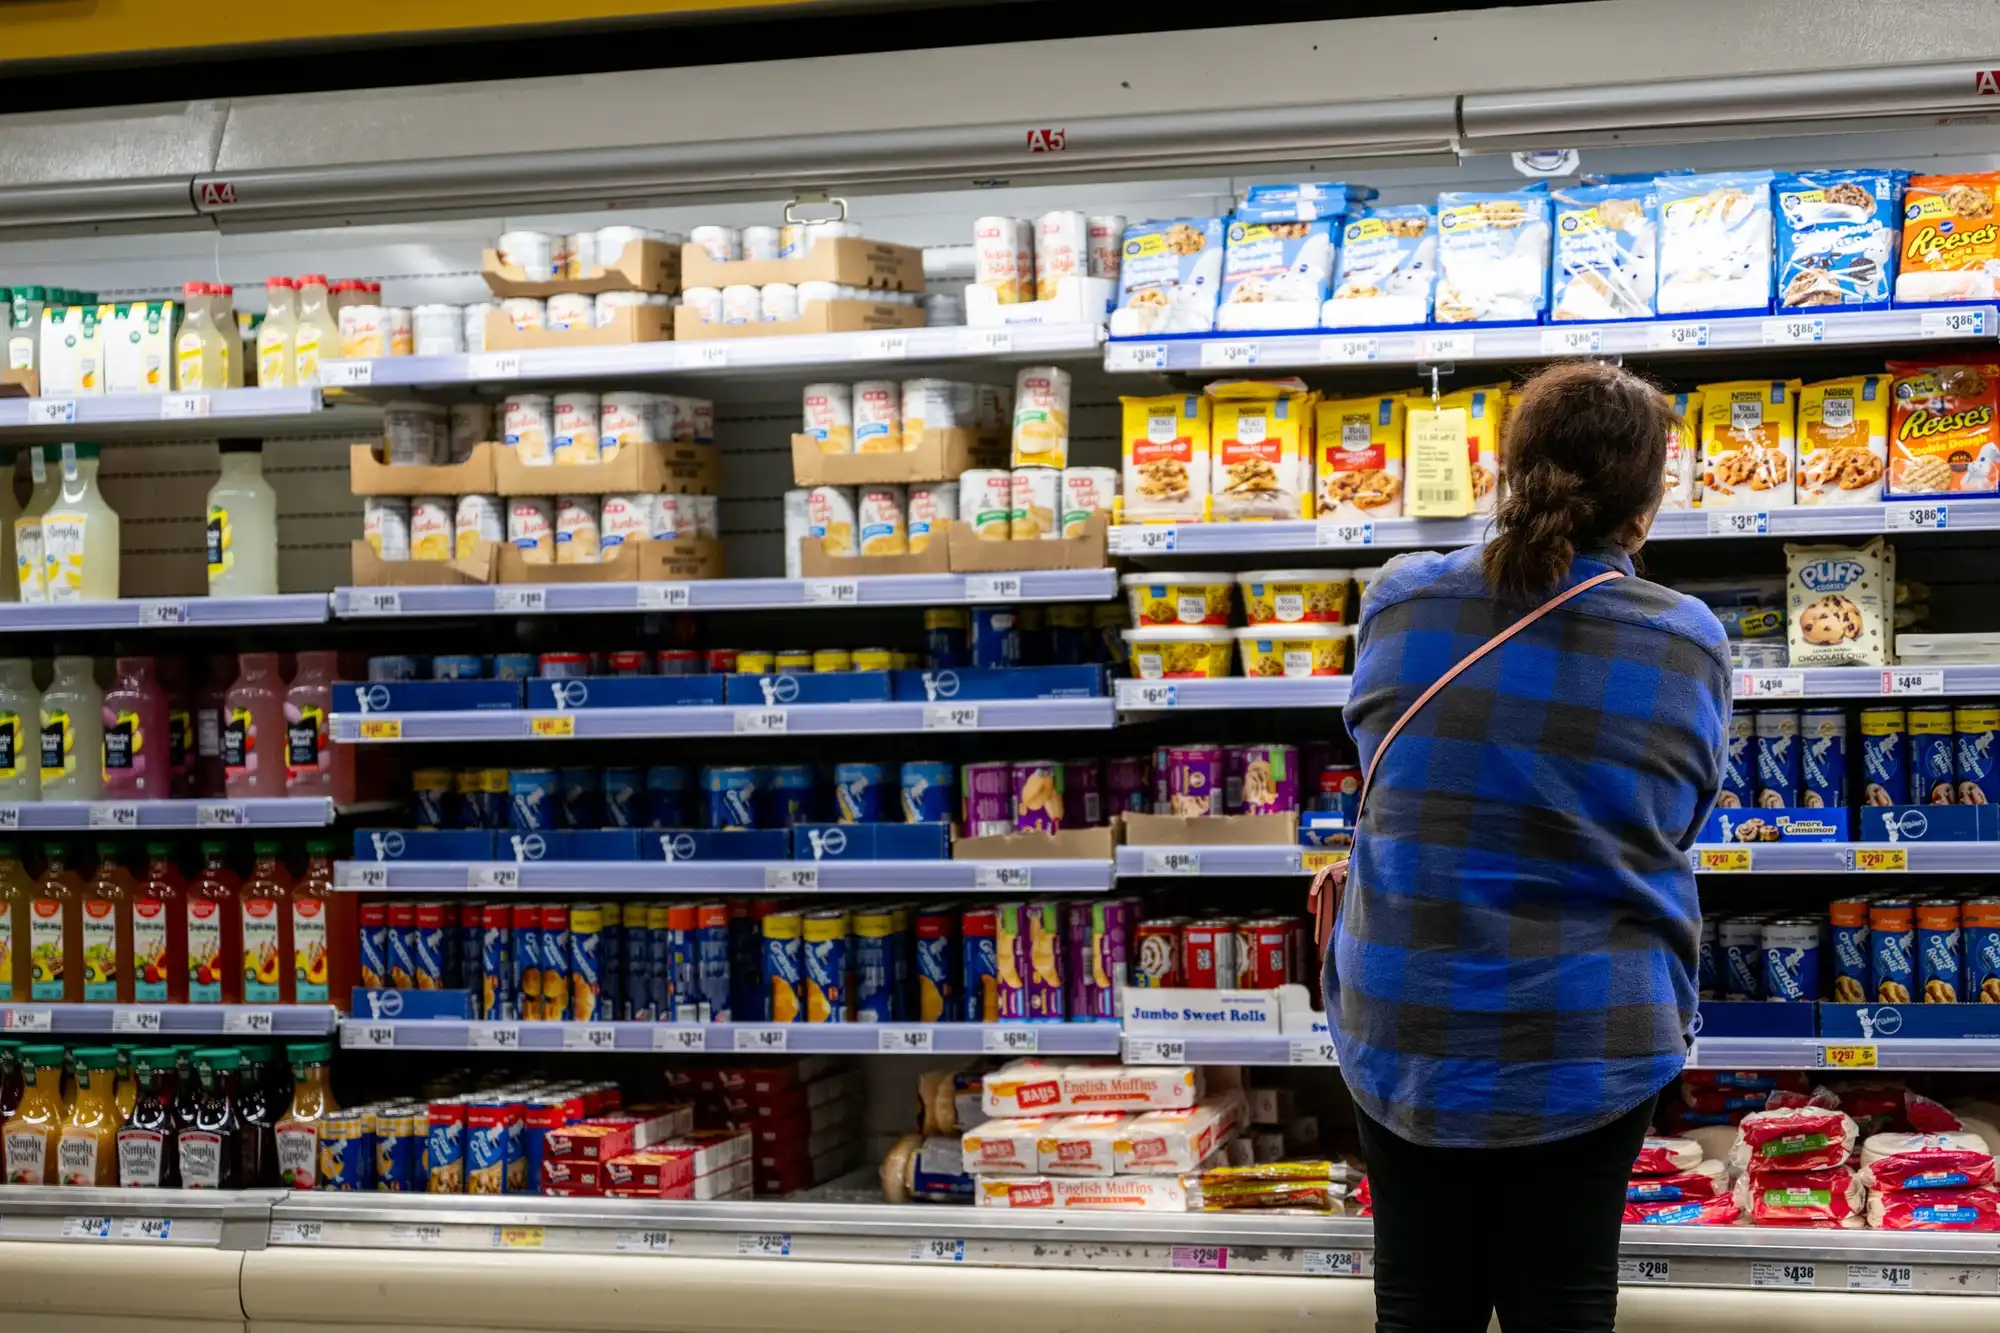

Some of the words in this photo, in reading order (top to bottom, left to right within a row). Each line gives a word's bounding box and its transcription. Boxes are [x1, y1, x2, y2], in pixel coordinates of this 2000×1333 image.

[1029, 128, 1065, 152] A5
[203, 183, 236, 205] A4
[1906, 224, 2000, 259] Reese's
[1786, 323, 1813, 337] $386
[1946, 314, 1973, 330] $386
[1672, 326, 1698, 341] $386
[1899, 405, 1993, 442] Reese's
[1731, 514, 1757, 529] $387
[1909, 508, 1936, 524] $386
[46, 525, 81, 541] Simply
[1799, 561, 1864, 588] PUFF
[1797, 653, 1844, 662] CHOCOLATE
[1759, 679, 1783, 692] $498
[1898, 676, 1922, 689] $448
[1142, 688, 1168, 702] $647
[1757, 737, 1788, 788] Cinnamon
[1784, 824, 1836, 834] Cinnamon
[1706, 853, 1730, 866] $297
[1861, 853, 1885, 866] $297
[1879, 947, 1899, 973] Rolls
[1883, 935, 1911, 973] Orange
[1926, 947, 1945, 972] Rolls
[1929, 935, 1957, 973] Orange
[1767, 947, 1804, 999] Grands!
[1131, 1007, 1179, 1021] Jumbo
[1183, 1008, 1225, 1021] Sweet
[1230, 1008, 1266, 1021] Rolls
[1831, 1051, 1855, 1063] $297
[1063, 1079, 1108, 1094] English
[1110, 1077, 1157, 1092] Muffins
[1173, 1084, 1183, 1097] 6
[7, 1134, 42, 1155] Simply
[60, 1138, 95, 1157] Simply
[121, 1140, 157, 1160] Simply
[183, 1141, 216, 1160] Simply
[278, 1133, 312, 1153] Simply
[1057, 1182, 1102, 1196] English
[1106, 1181, 1154, 1195] Muffins
[1325, 1253, 1352, 1269] $238
[1638, 1261, 1669, 1278] $288
[1783, 1266, 1814, 1282] $438
[1881, 1268, 1911, 1284] $418
